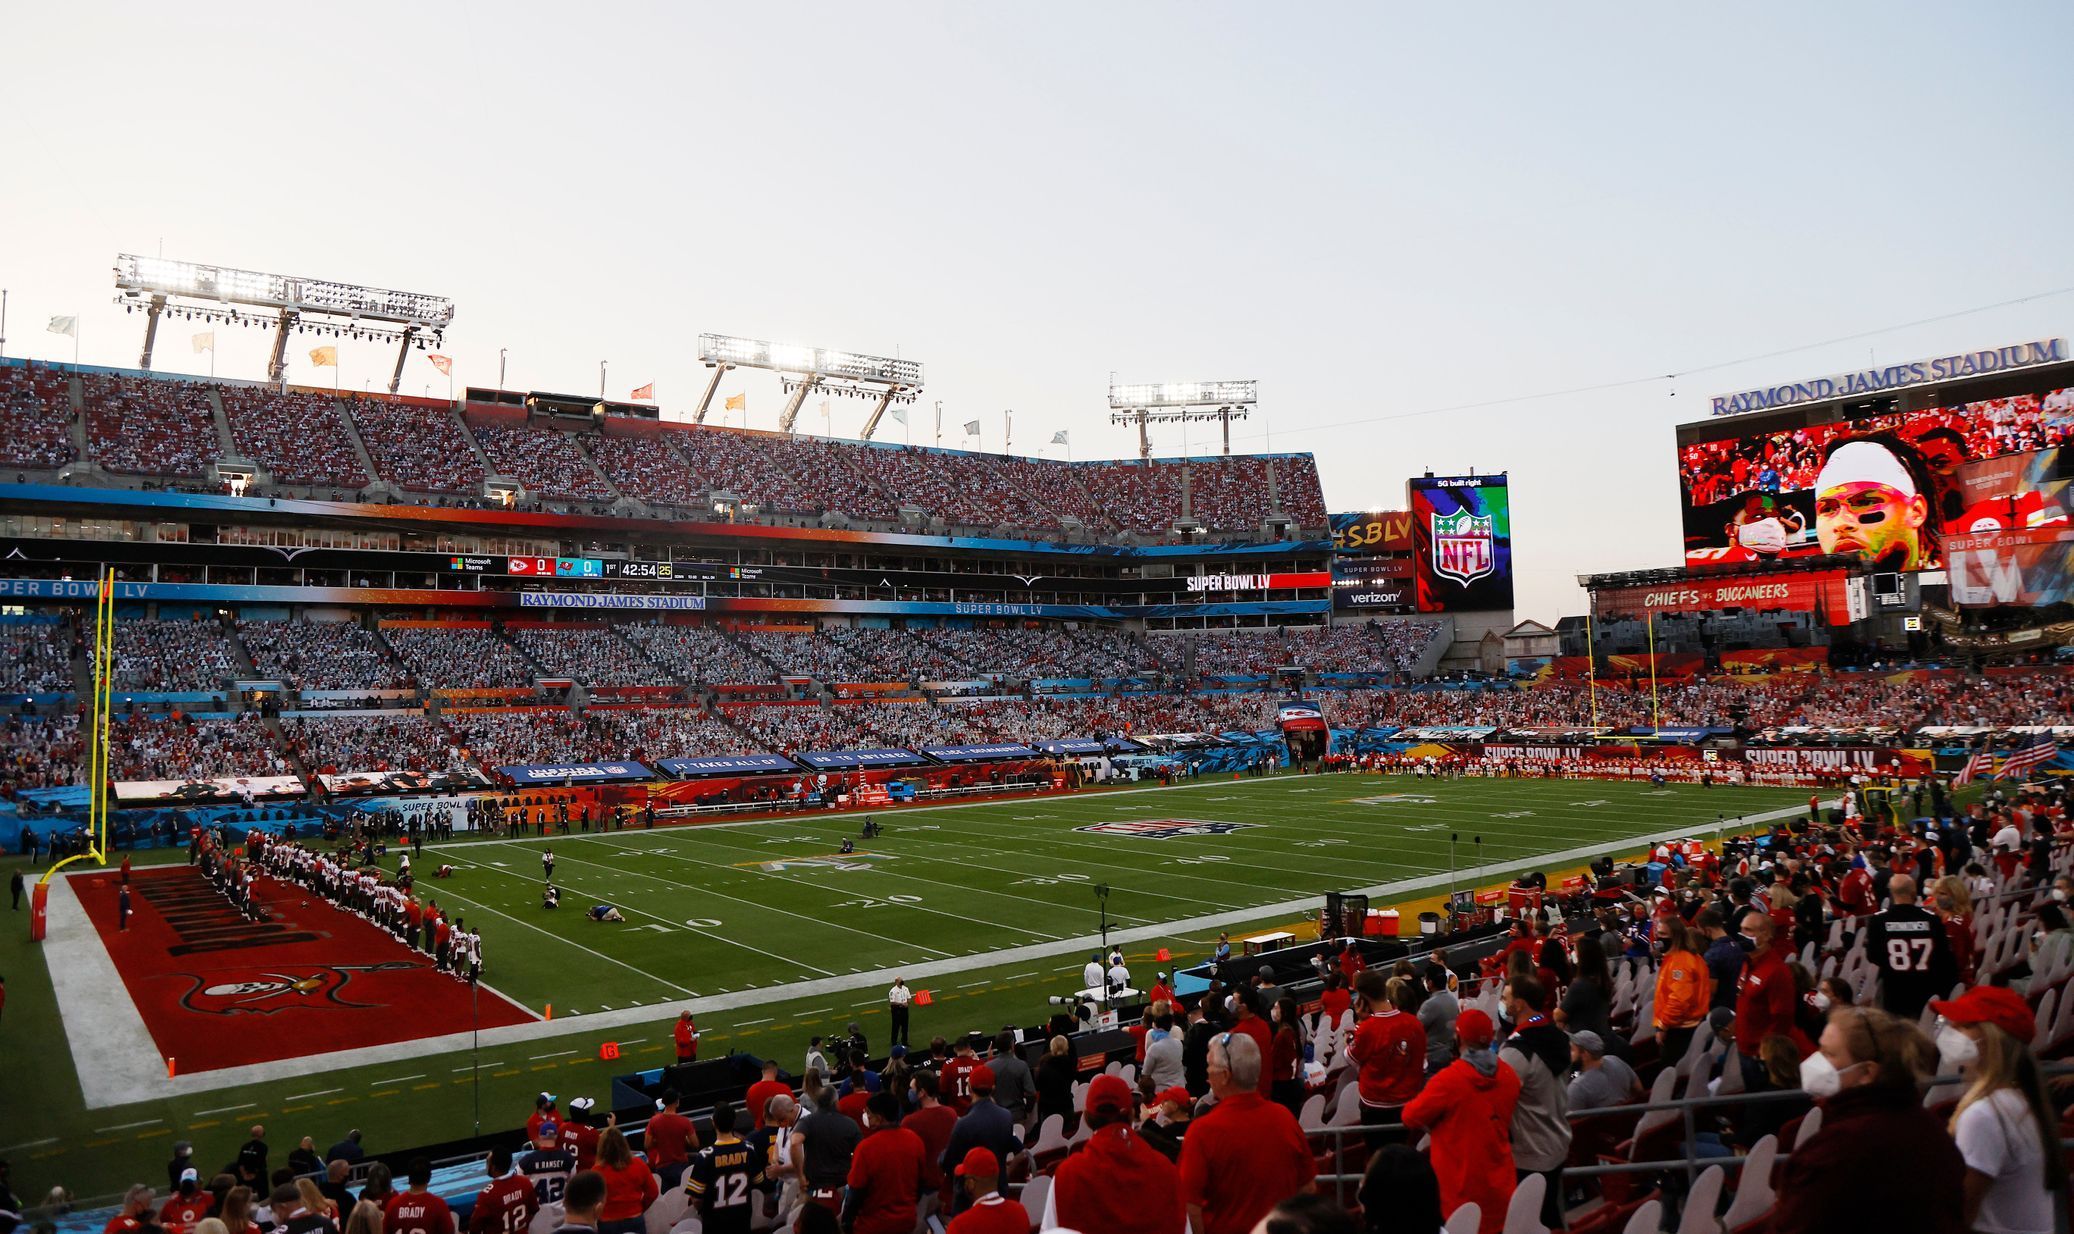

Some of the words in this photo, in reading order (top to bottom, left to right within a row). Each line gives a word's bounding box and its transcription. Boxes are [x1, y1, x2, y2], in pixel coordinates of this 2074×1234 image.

[1710, 378, 1834, 416] RAYMOND
[1838, 361, 1925, 396] JAMES
[1931, 338, 2059, 380] STADIUM
[1465, 479, 1482, 488] right
[1949, 537, 1992, 551] SUPER
[465, 557, 492, 566] Microsoft
[1440, 539, 1489, 575] NFL
[537, 559, 546, 571] 0
[583, 561, 592, 572] 0
[622, 564, 657, 577] 42:54
[659, 566, 672, 576] 25
[1187, 575, 1223, 591] SUPER
[1224, 574, 1256, 590] BOWL
[1257, 574, 1271, 589] LV
[125, 584, 148, 597] LV
[1350, 591, 1397, 603] verizon
[1644, 589, 1700, 607] CHIEFS
[1715, 583, 1789, 603] BUCCANEERS
[522, 593, 597, 607] RAYMOND
[599, 595, 644, 609] JAMES
[647, 597, 705, 610] STADIUM
[955, 604, 991, 614] SUPER
[996, 605, 1026, 615] BOWL
[1031, 606, 1042, 615] LV
[690, 761, 733, 769] TAKES
[402, 802, 434, 812] SUPER
[436, 800, 462, 810] BOWL
[846, 894, 923, 909] 20
[640, 918, 722, 934] 10
[1886, 938, 1933, 971] 87
[714, 1151, 748, 1169] BRADY
[502, 1188, 524, 1205] BRADY
[534, 1177, 566, 1205] 42
[713, 1172, 748, 1209] 12
[398, 1206, 426, 1219] BRADY
[502, 1204, 527, 1233] 12
